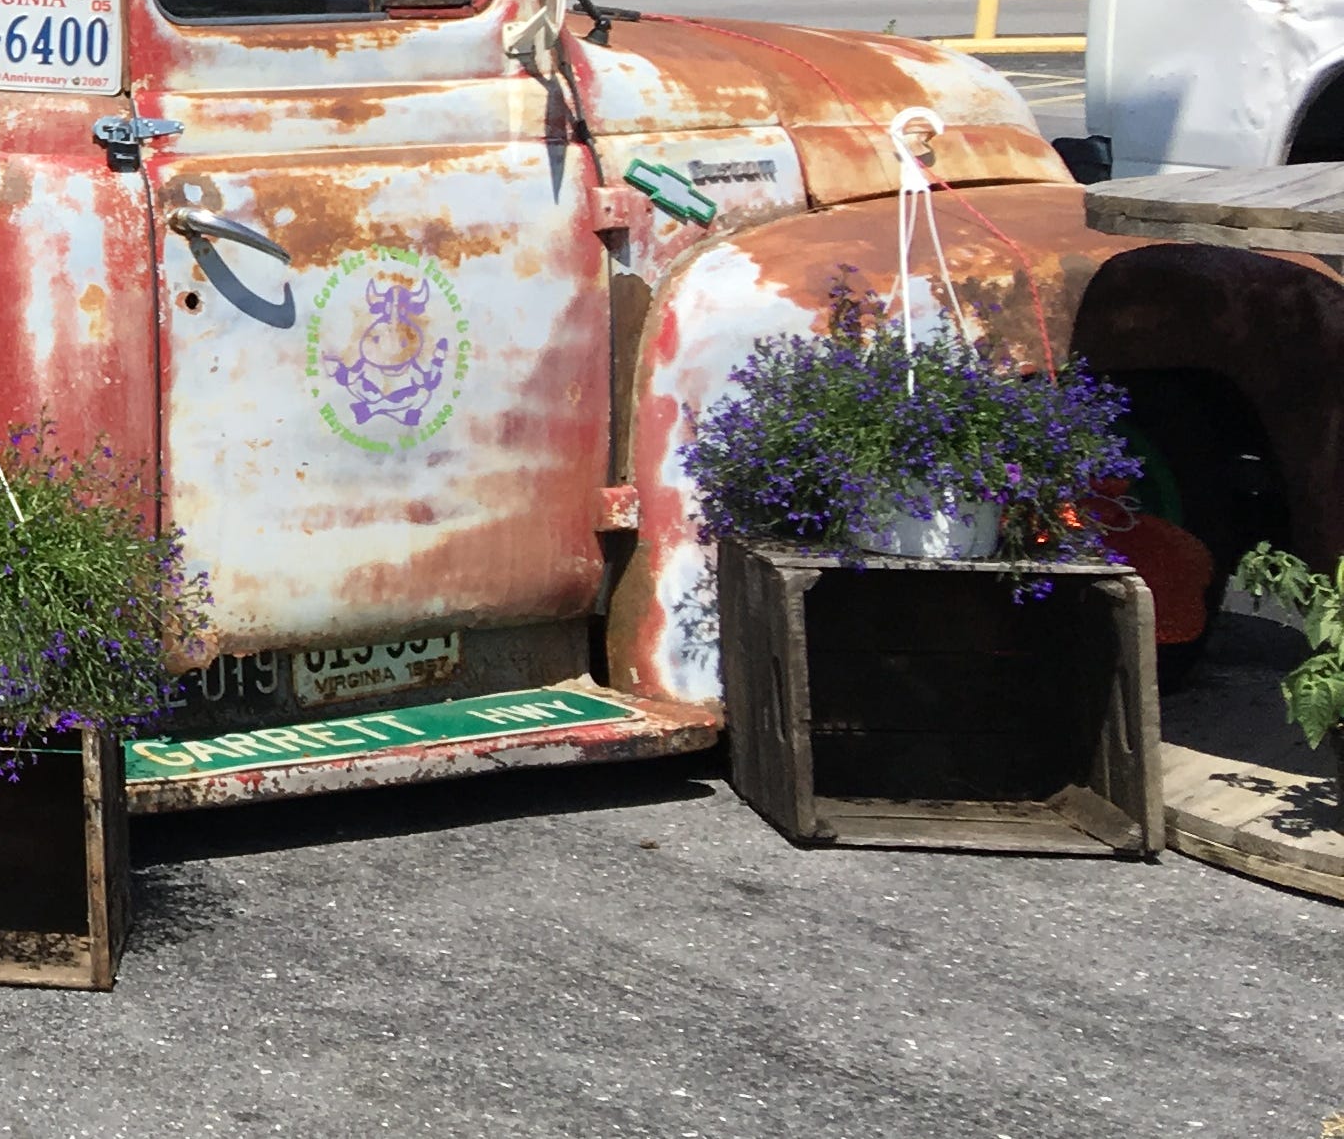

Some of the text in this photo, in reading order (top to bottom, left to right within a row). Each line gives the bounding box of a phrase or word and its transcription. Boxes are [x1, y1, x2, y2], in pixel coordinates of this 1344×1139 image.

[91, 0, 112, 12] 05
[1, 71, 68, 87] Anniversary
[81, 76, 109, 86] 2007
[313, 272, 340, 309] Cow
[314, 666, 396, 694] VIRGINIA
[133, 700, 585, 767] GARRETT HWY
